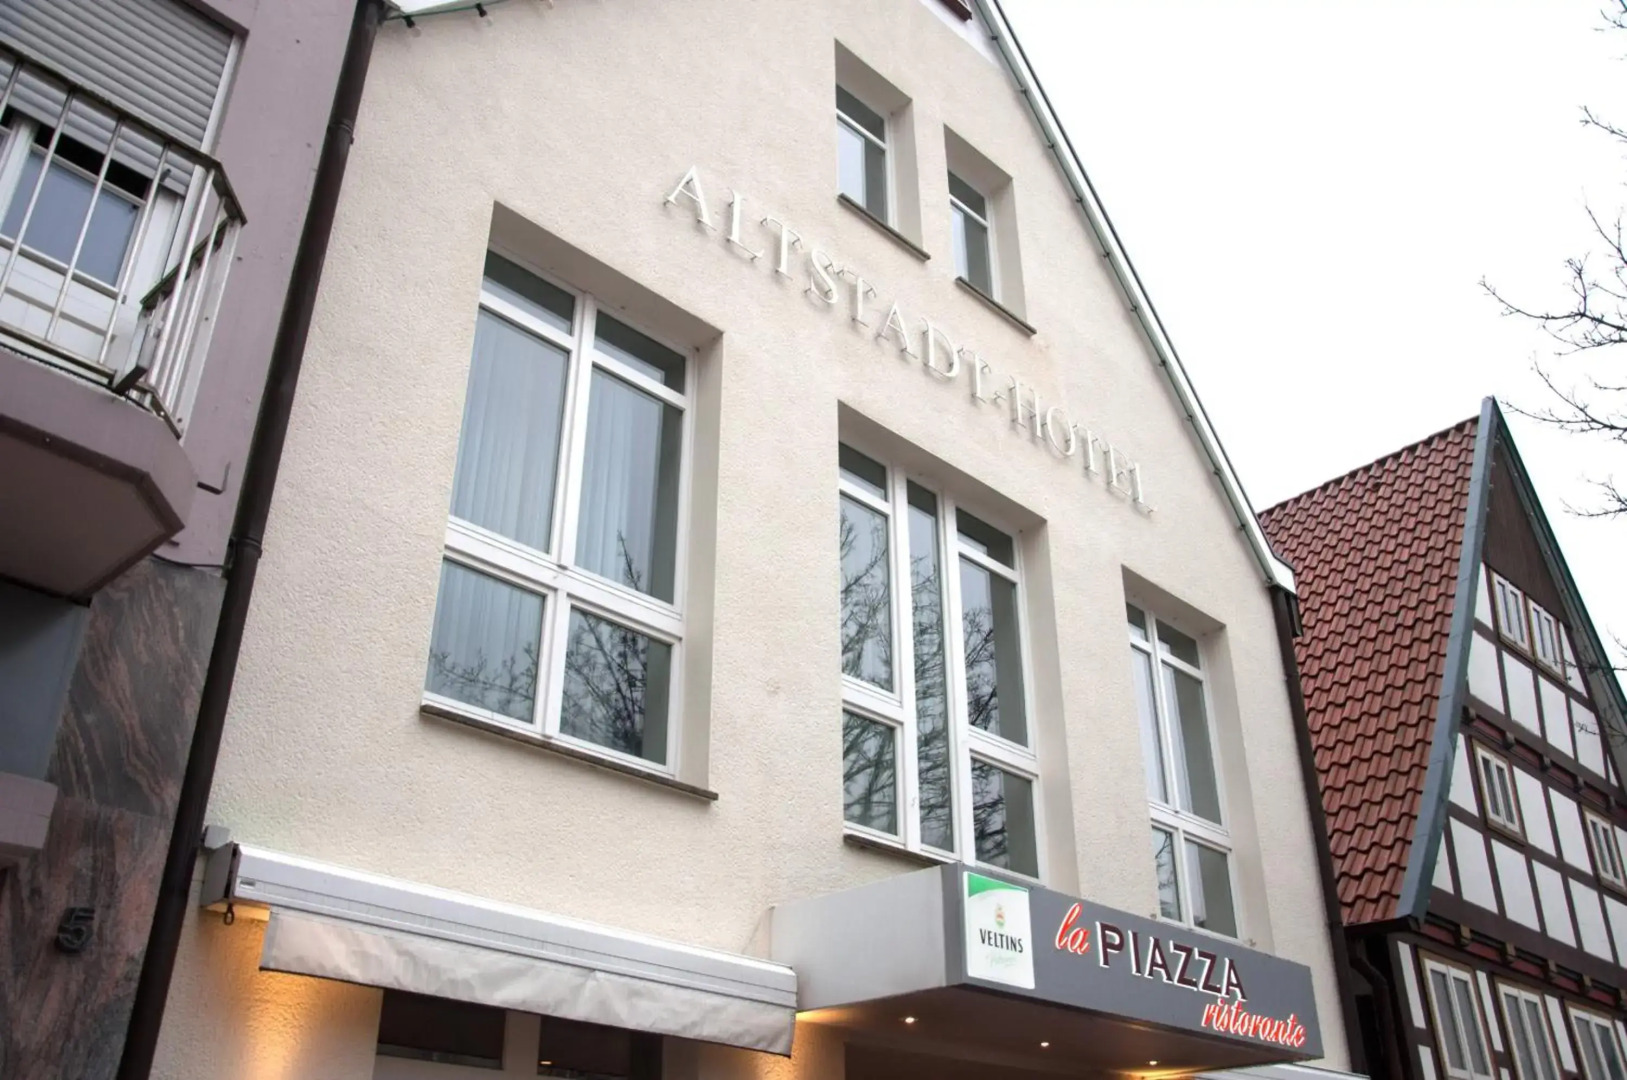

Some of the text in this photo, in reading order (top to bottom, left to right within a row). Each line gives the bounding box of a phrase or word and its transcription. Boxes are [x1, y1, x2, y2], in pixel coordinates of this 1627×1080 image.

[665, 165, 1157, 515] ALTSTADT-HOTEL
[56, 907, 95, 953] 5
[979, 927, 1024, 954] VELTINS
[1054, 903, 1248, 1001] la PIAZZA
[1202, 999, 1305, 1047] ristorante
